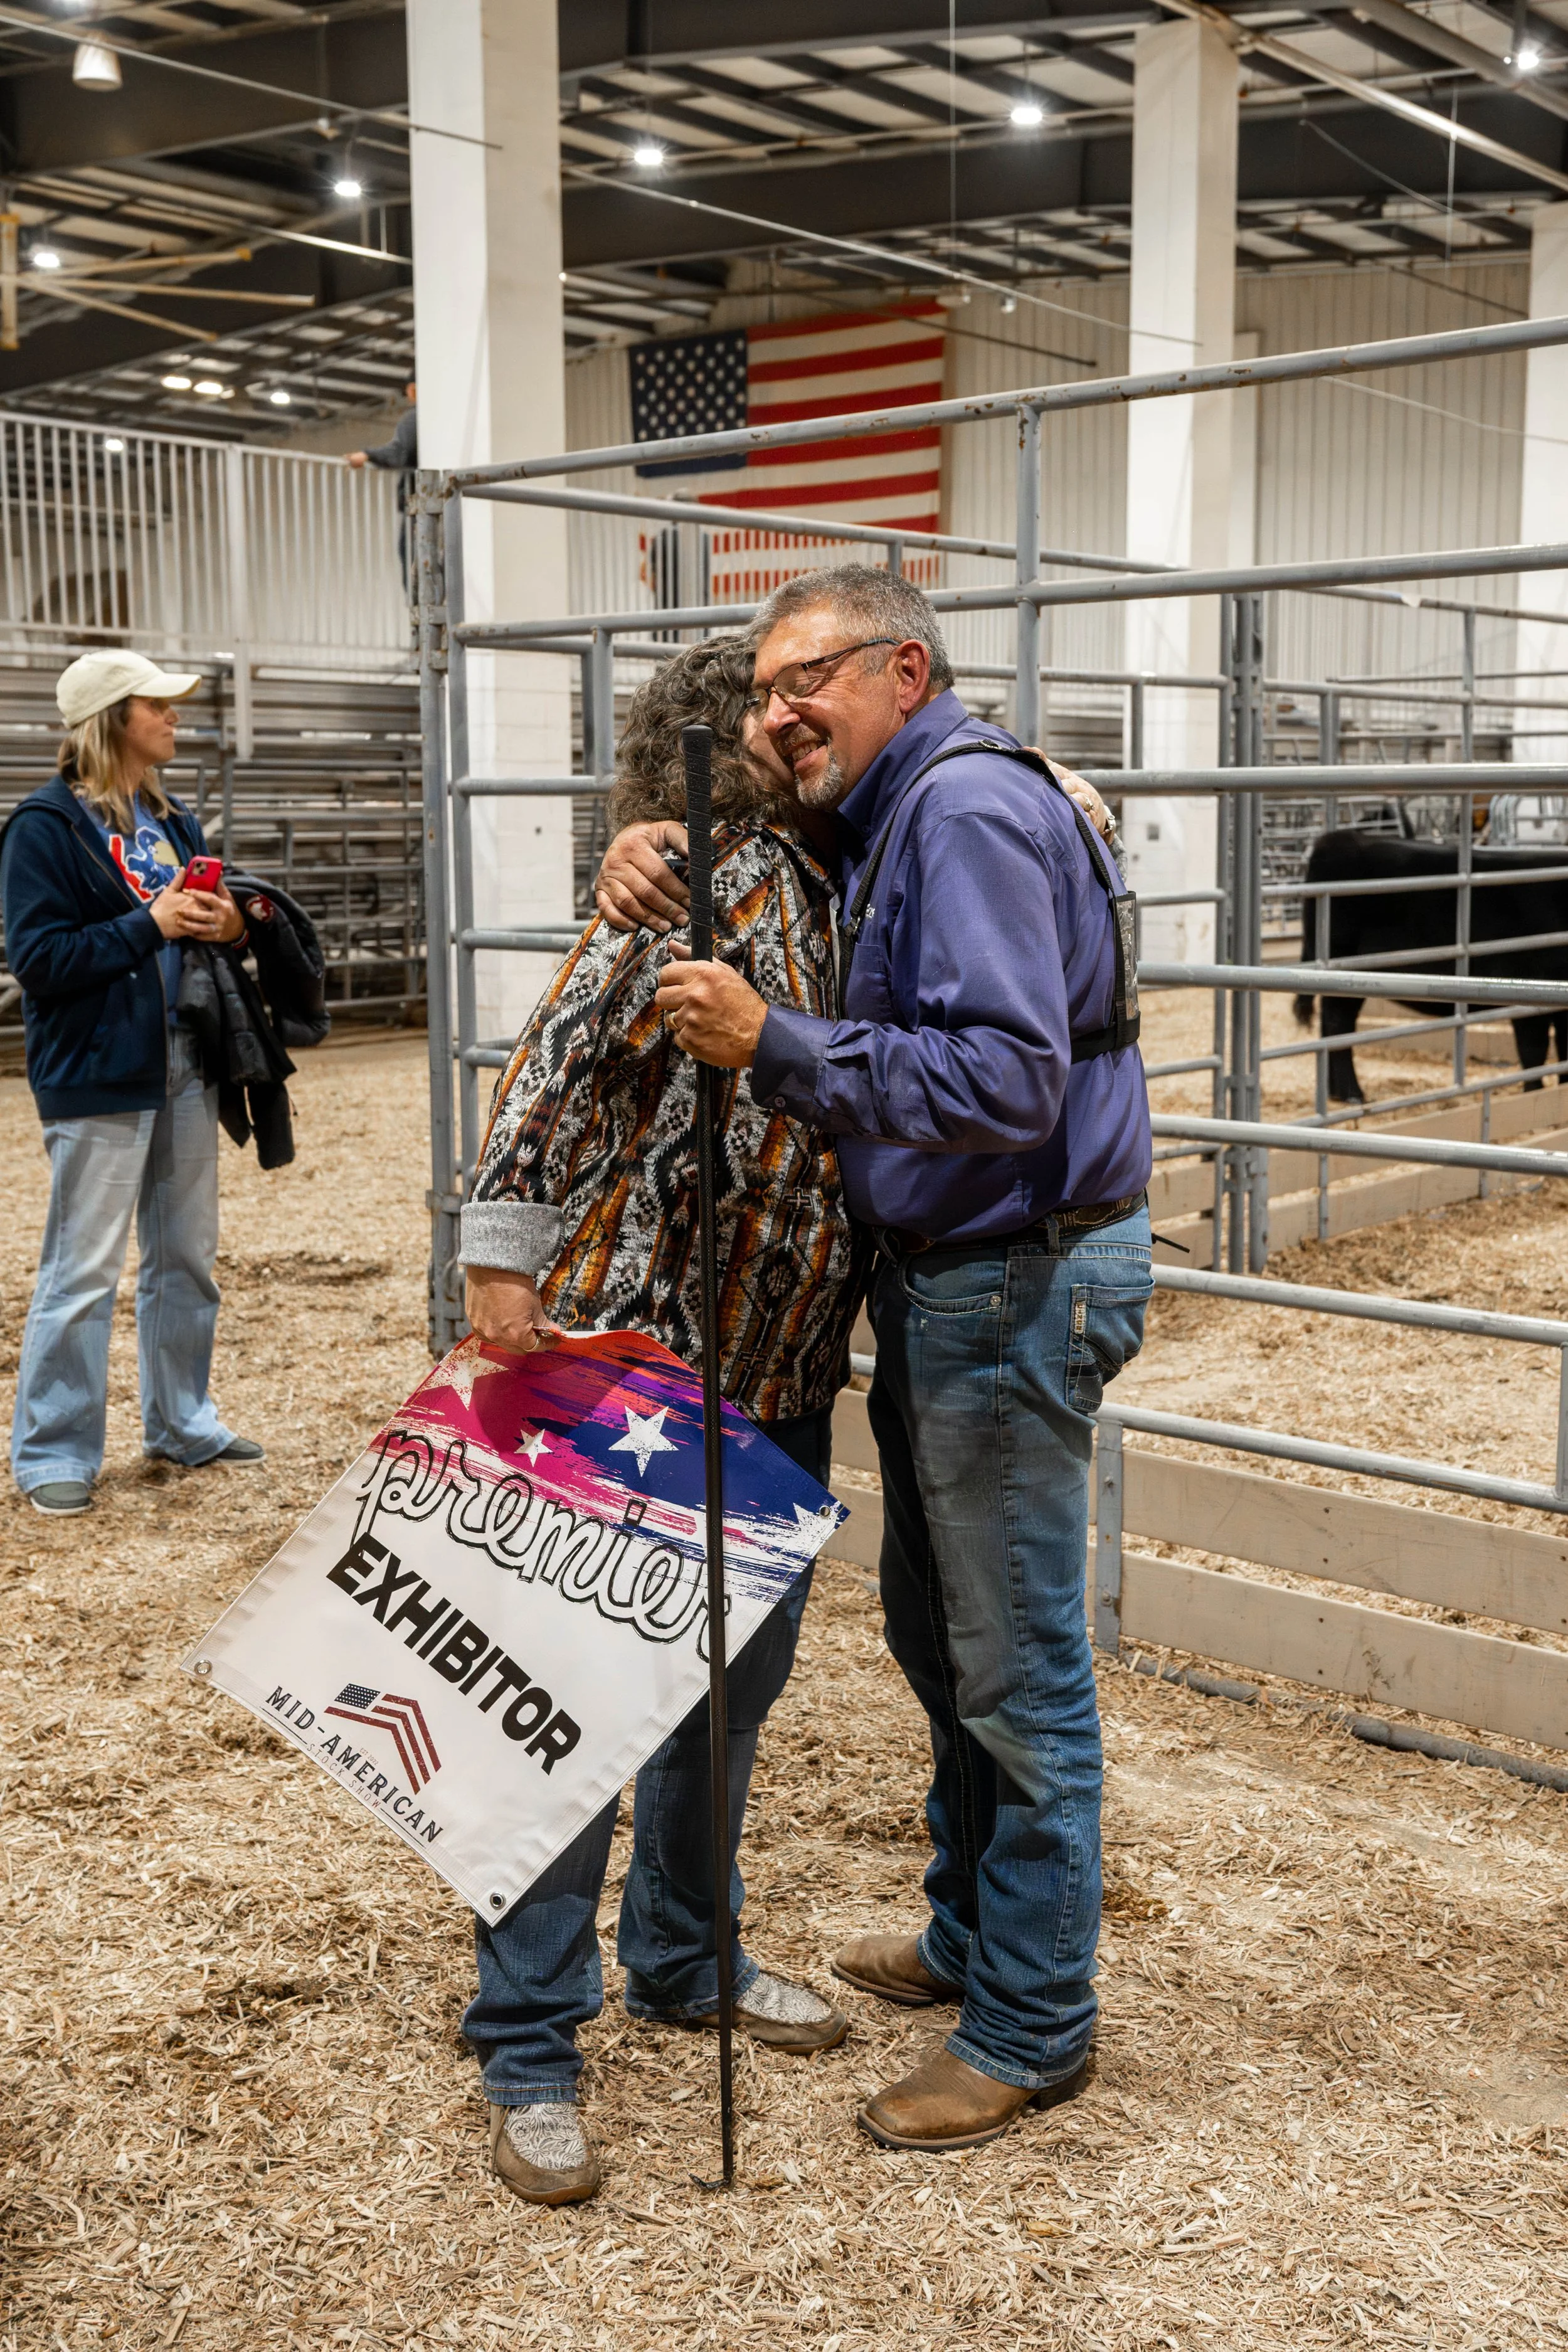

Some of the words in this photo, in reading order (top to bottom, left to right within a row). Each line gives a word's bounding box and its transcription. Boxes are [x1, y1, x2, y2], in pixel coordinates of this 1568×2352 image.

[356, 1429, 733, 1663] premier
[326, 1532, 581, 1776] EXHIBITOR
[265, 1685, 443, 1843] MID-AMERICAN
[307, 1743, 346, 1777] STOCK
[347, 1780, 381, 1809] SHOW
